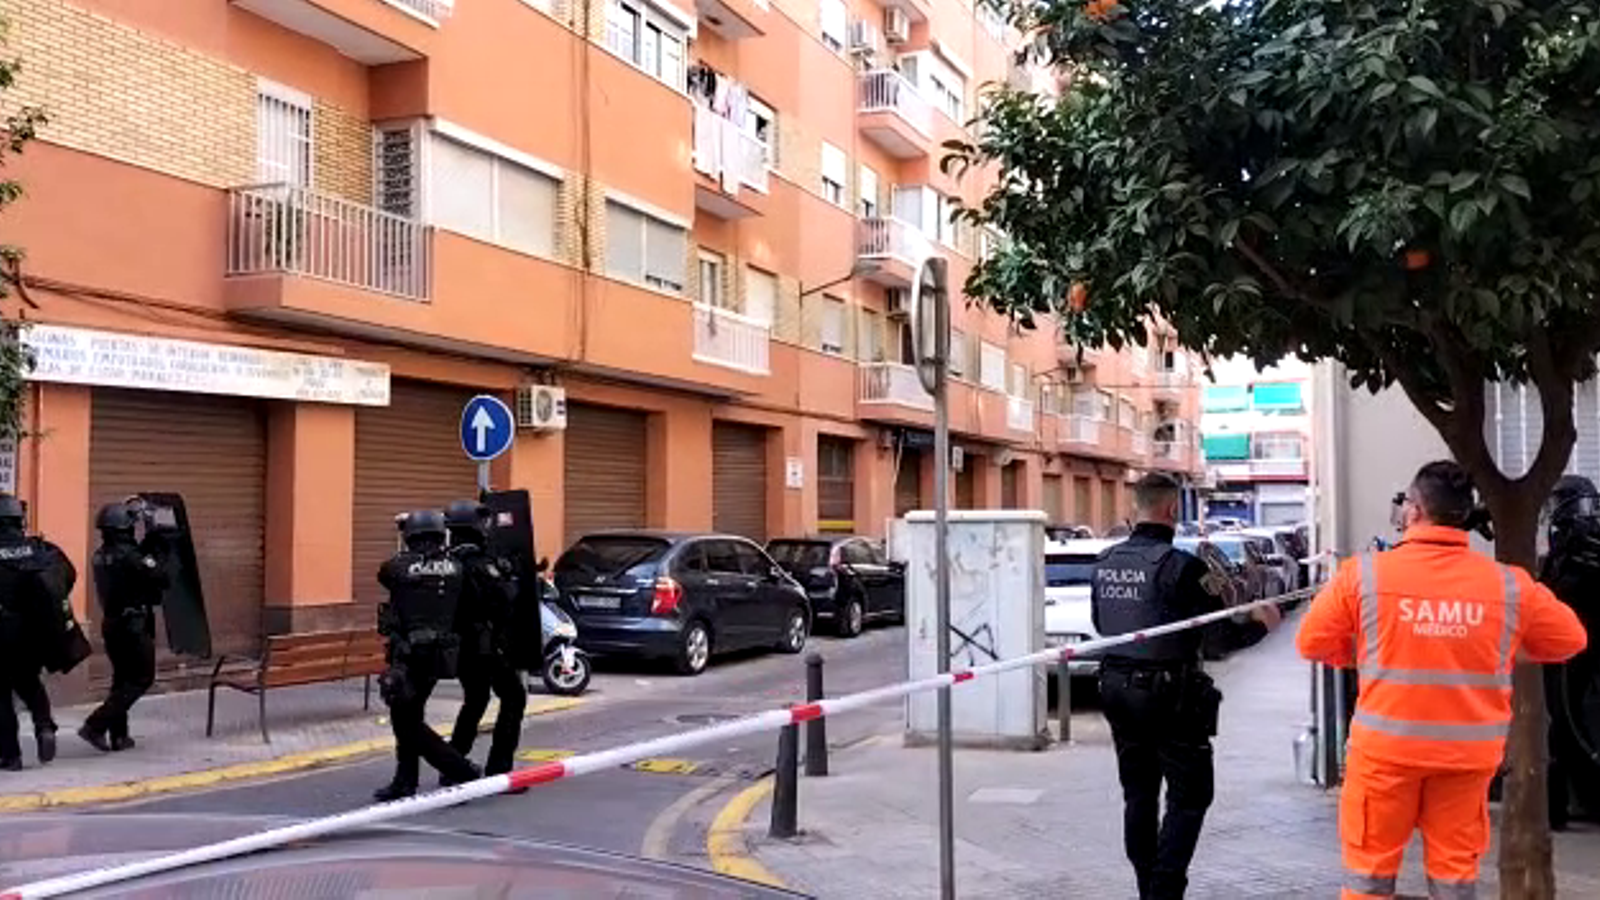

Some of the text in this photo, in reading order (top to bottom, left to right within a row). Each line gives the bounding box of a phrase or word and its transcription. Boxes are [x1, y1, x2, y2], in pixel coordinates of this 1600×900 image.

[1098, 568, 1146, 584] POLICIA
[1100, 584, 1142, 601] LOCAL
[1398, 598, 1484, 627] SAMU
